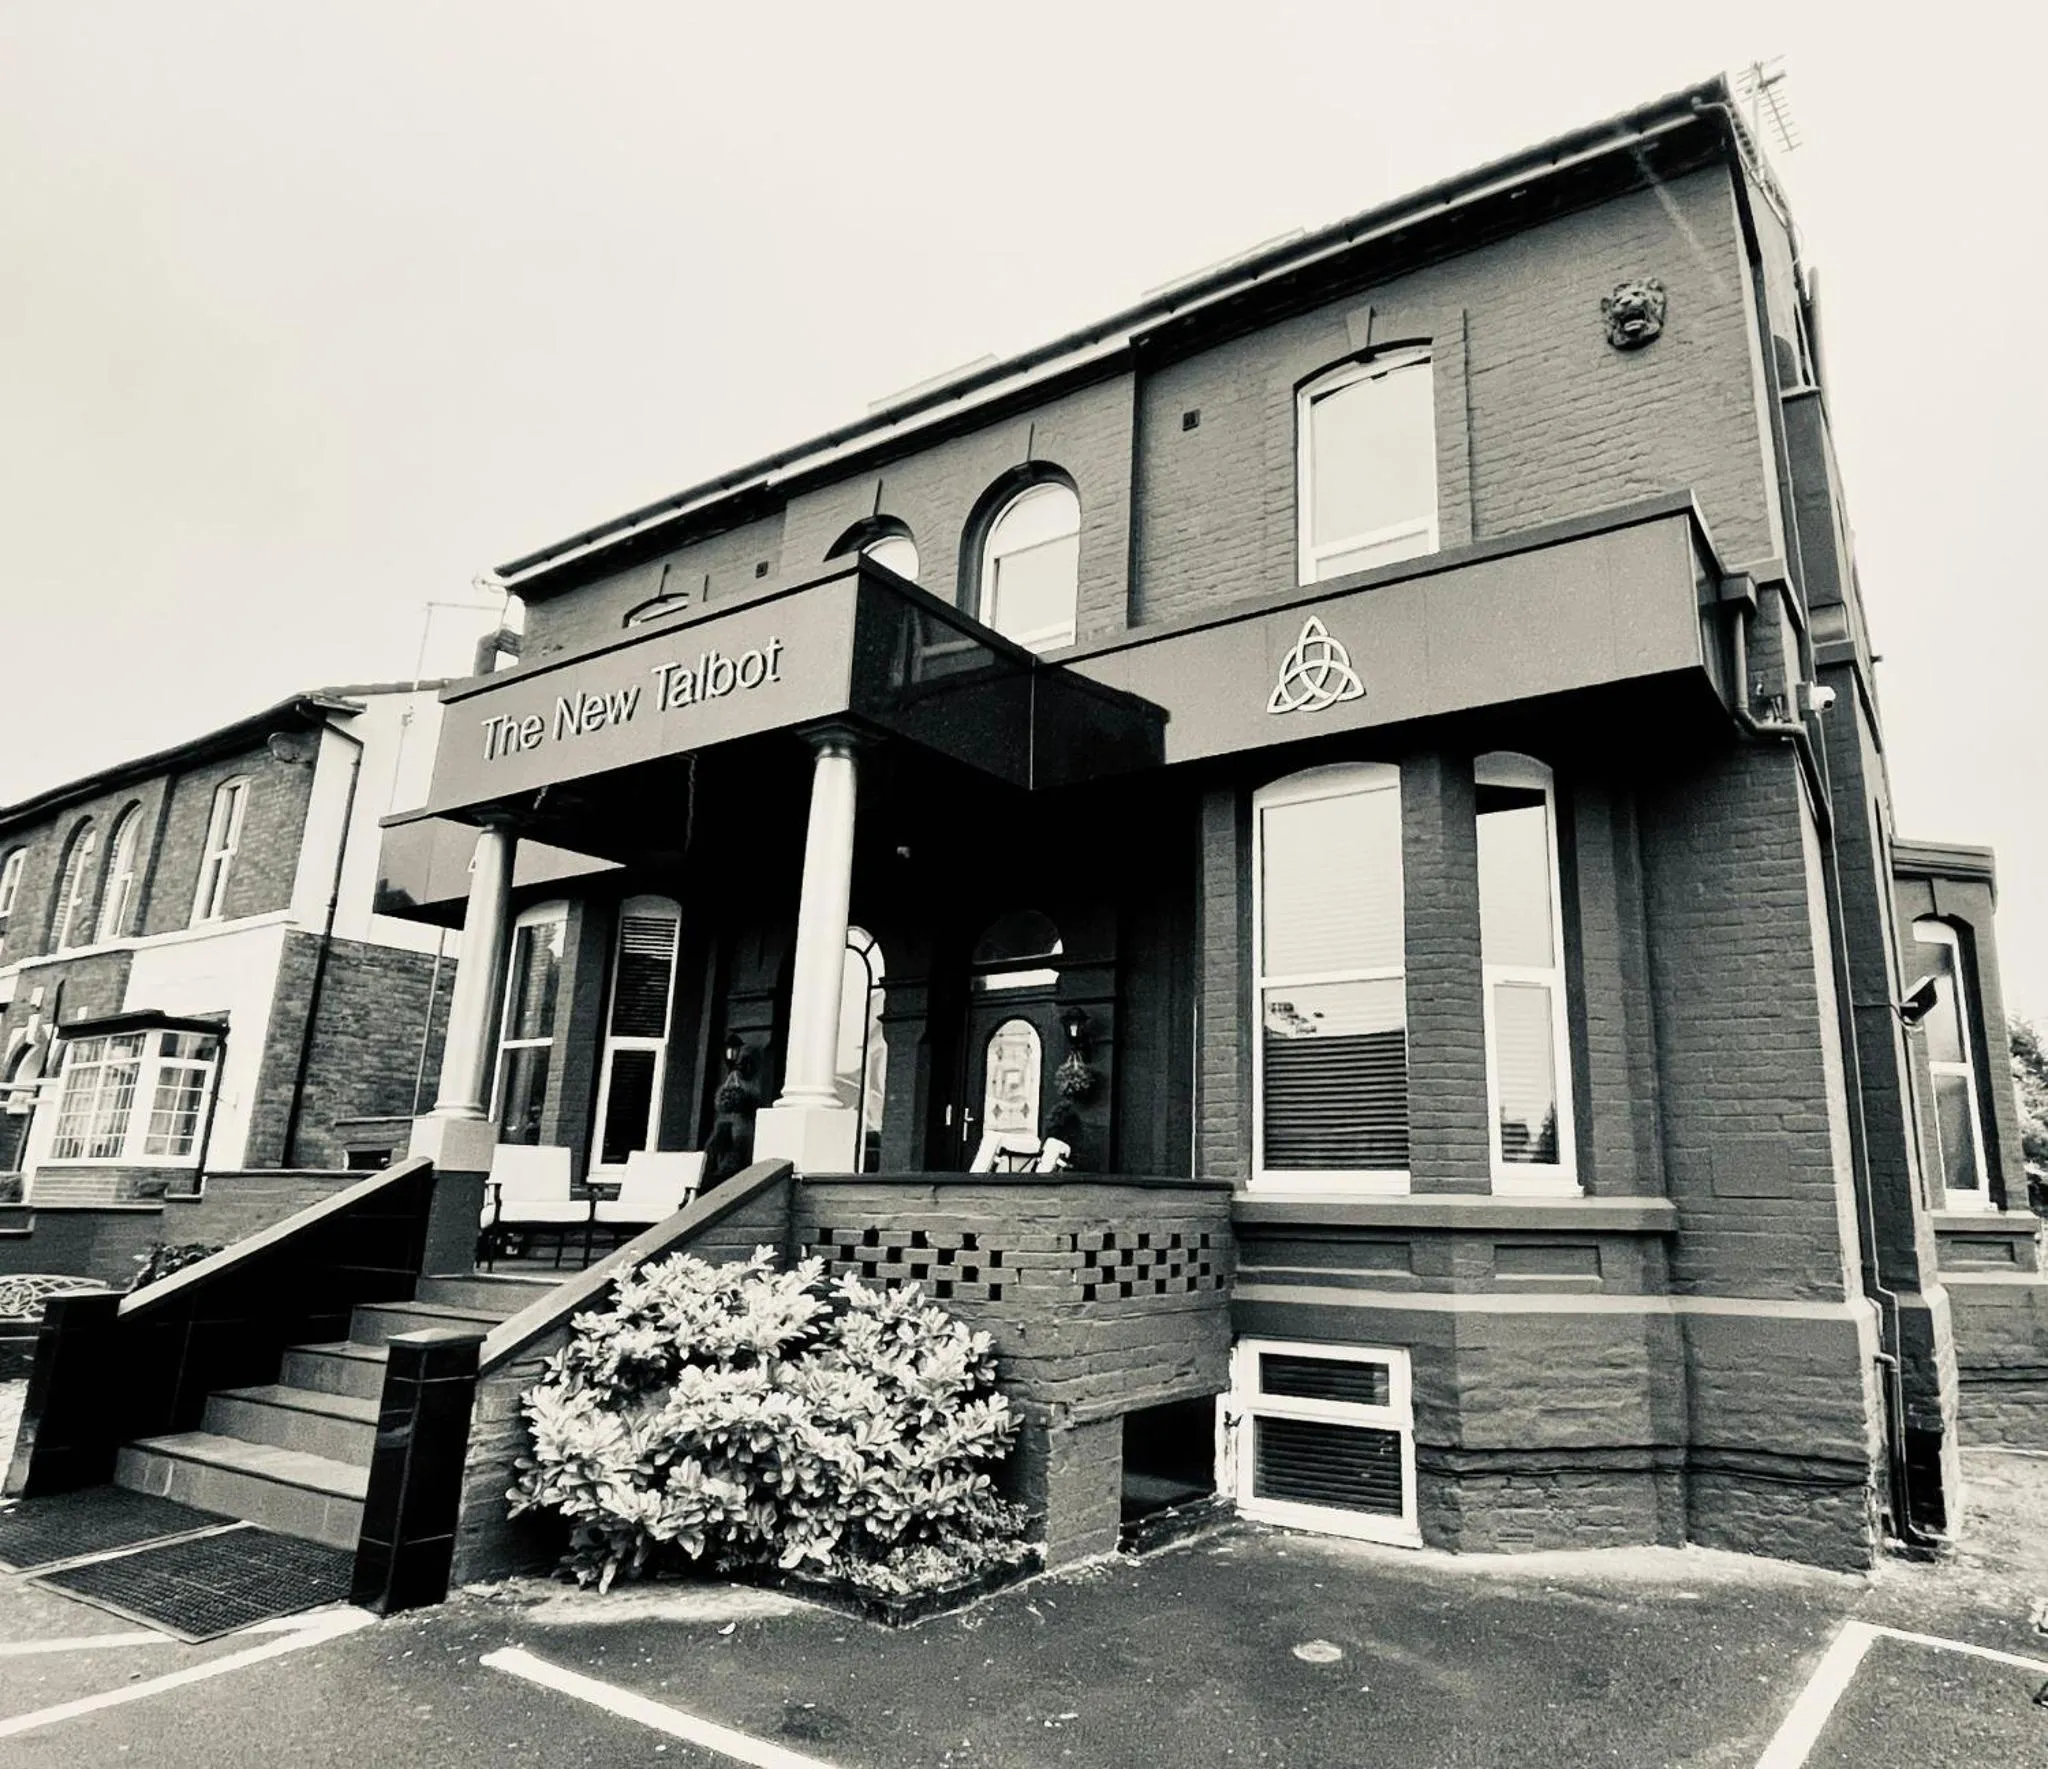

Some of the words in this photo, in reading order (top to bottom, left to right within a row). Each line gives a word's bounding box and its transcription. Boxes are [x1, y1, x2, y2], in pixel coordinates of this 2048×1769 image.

[482, 714, 544, 759] The
[553, 685, 640, 740] New
[651, 637, 783, 710] Talbot
